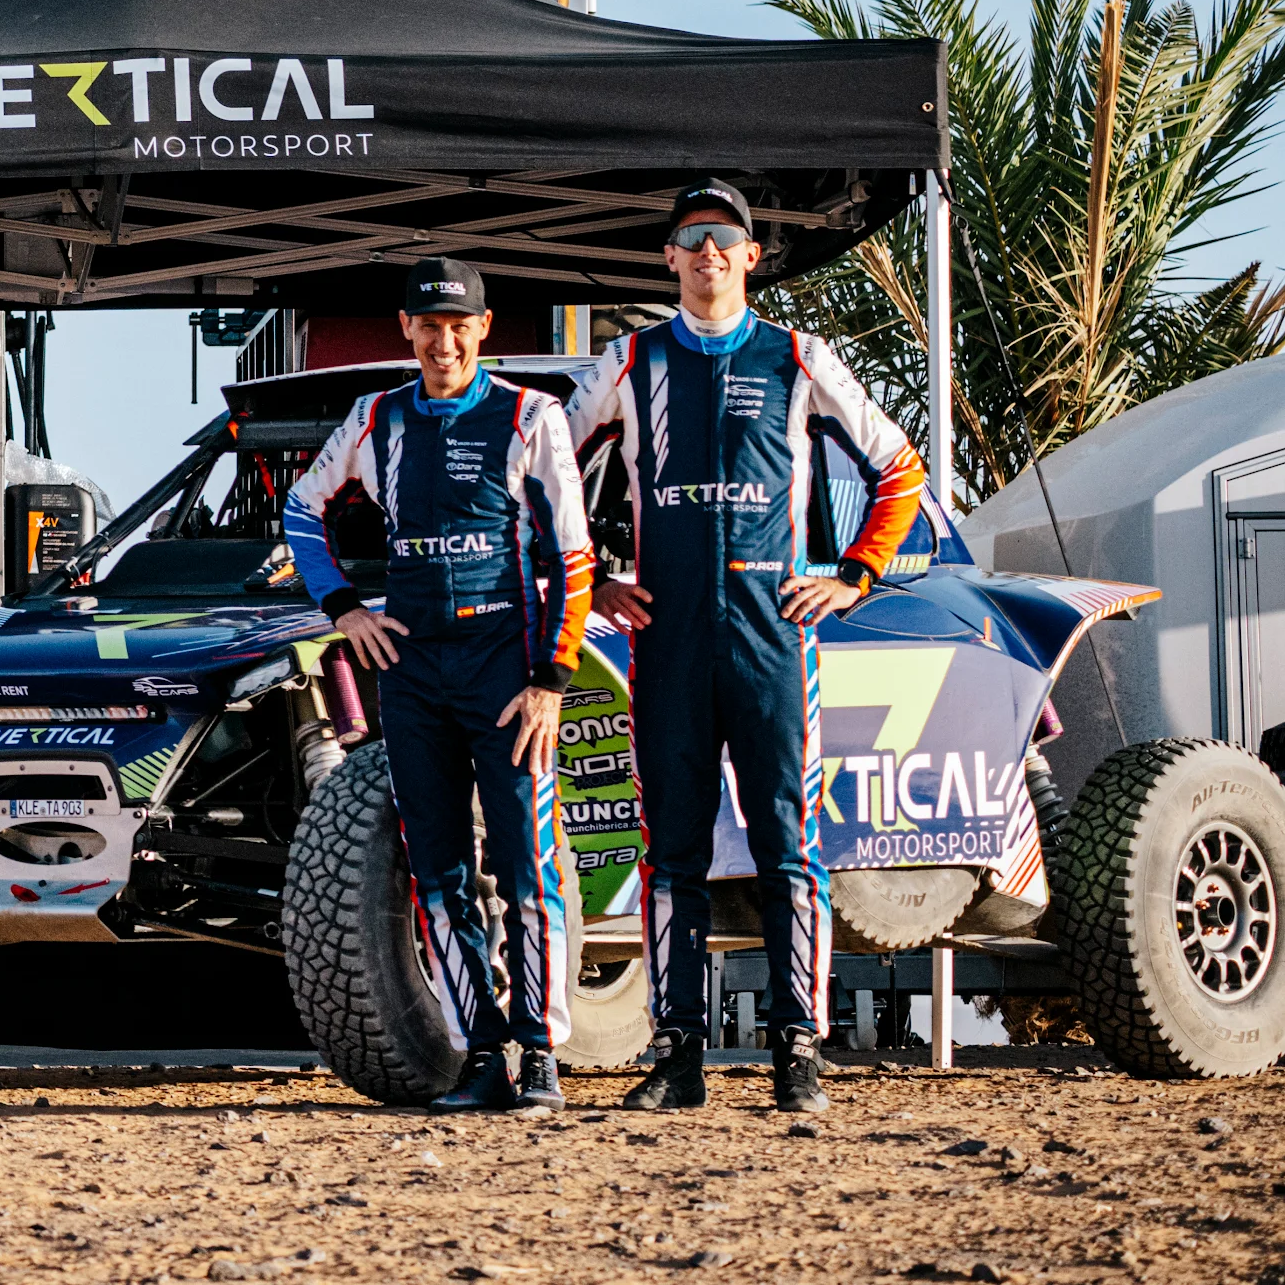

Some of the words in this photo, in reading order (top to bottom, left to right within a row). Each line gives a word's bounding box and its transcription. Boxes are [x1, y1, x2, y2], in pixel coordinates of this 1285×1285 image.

[134, 133, 374, 159] MOTORSPORT
[653, 482, 771, 507] VERTICAL
[429, 552, 494, 564] MOTORSPORT
[2, 685, 29, 697] RENT
[18, 801, 39, 815] KLE
[46, 801, 60, 815] TA
[62, 801, 82, 815] 903
[560, 801, 640, 823] AUNC
[856, 830, 1004, 860] MOTORSPORT
